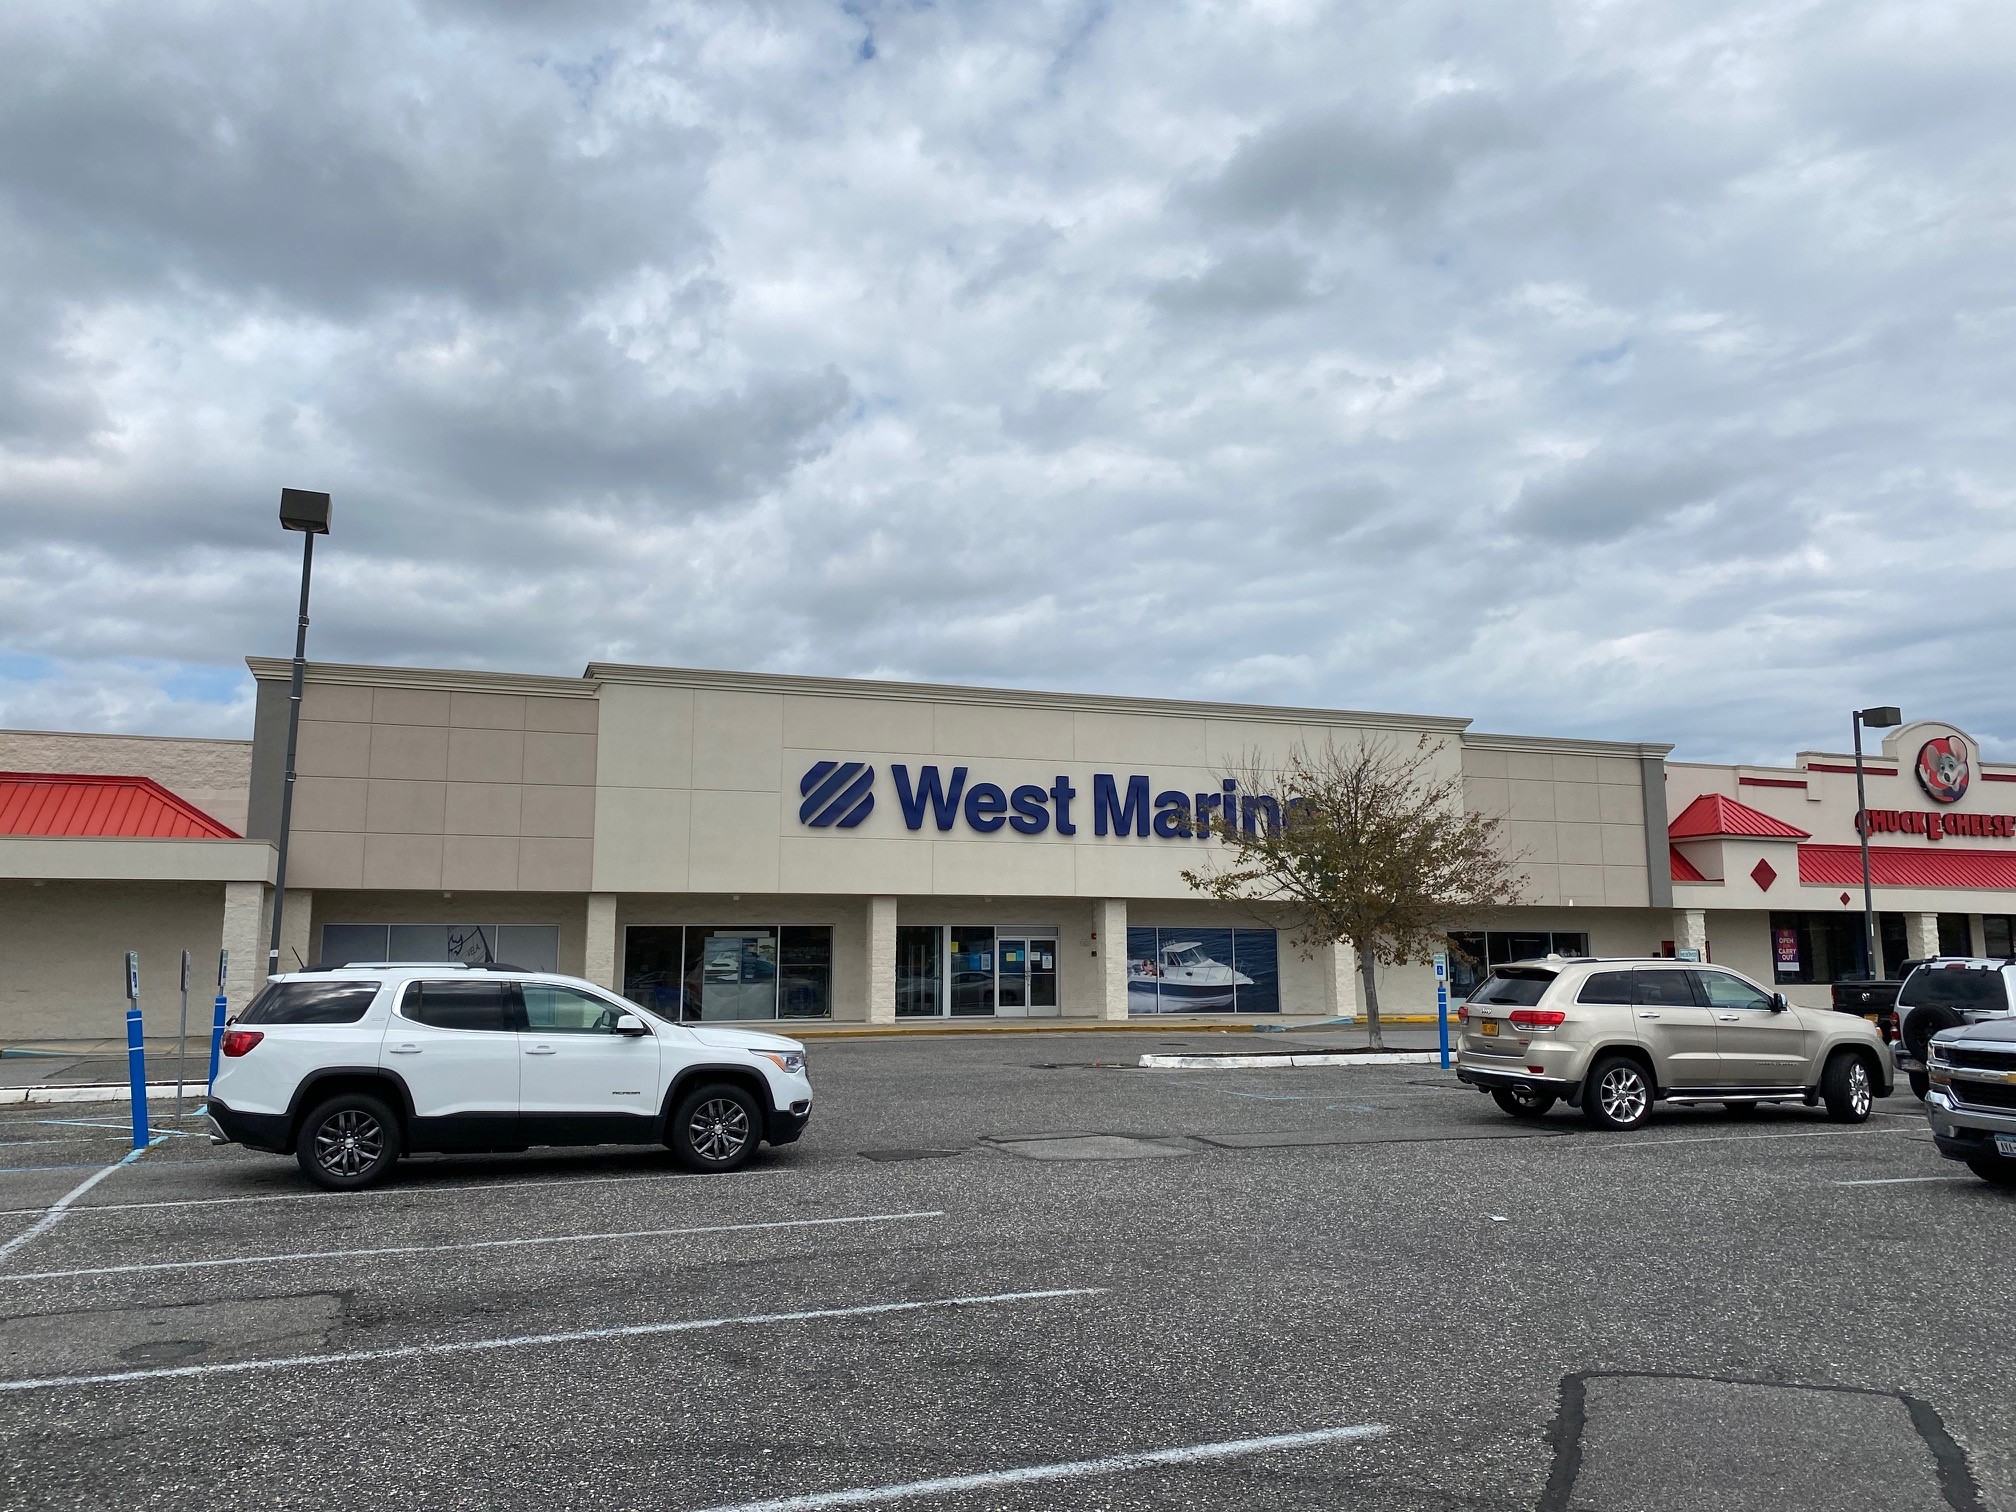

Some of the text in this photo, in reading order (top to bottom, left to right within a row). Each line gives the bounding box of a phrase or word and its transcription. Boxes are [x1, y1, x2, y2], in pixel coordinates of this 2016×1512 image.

[891, 764, 1076, 835] West
[1855, 809, 2016, 840] CHUCK E CHEESE
